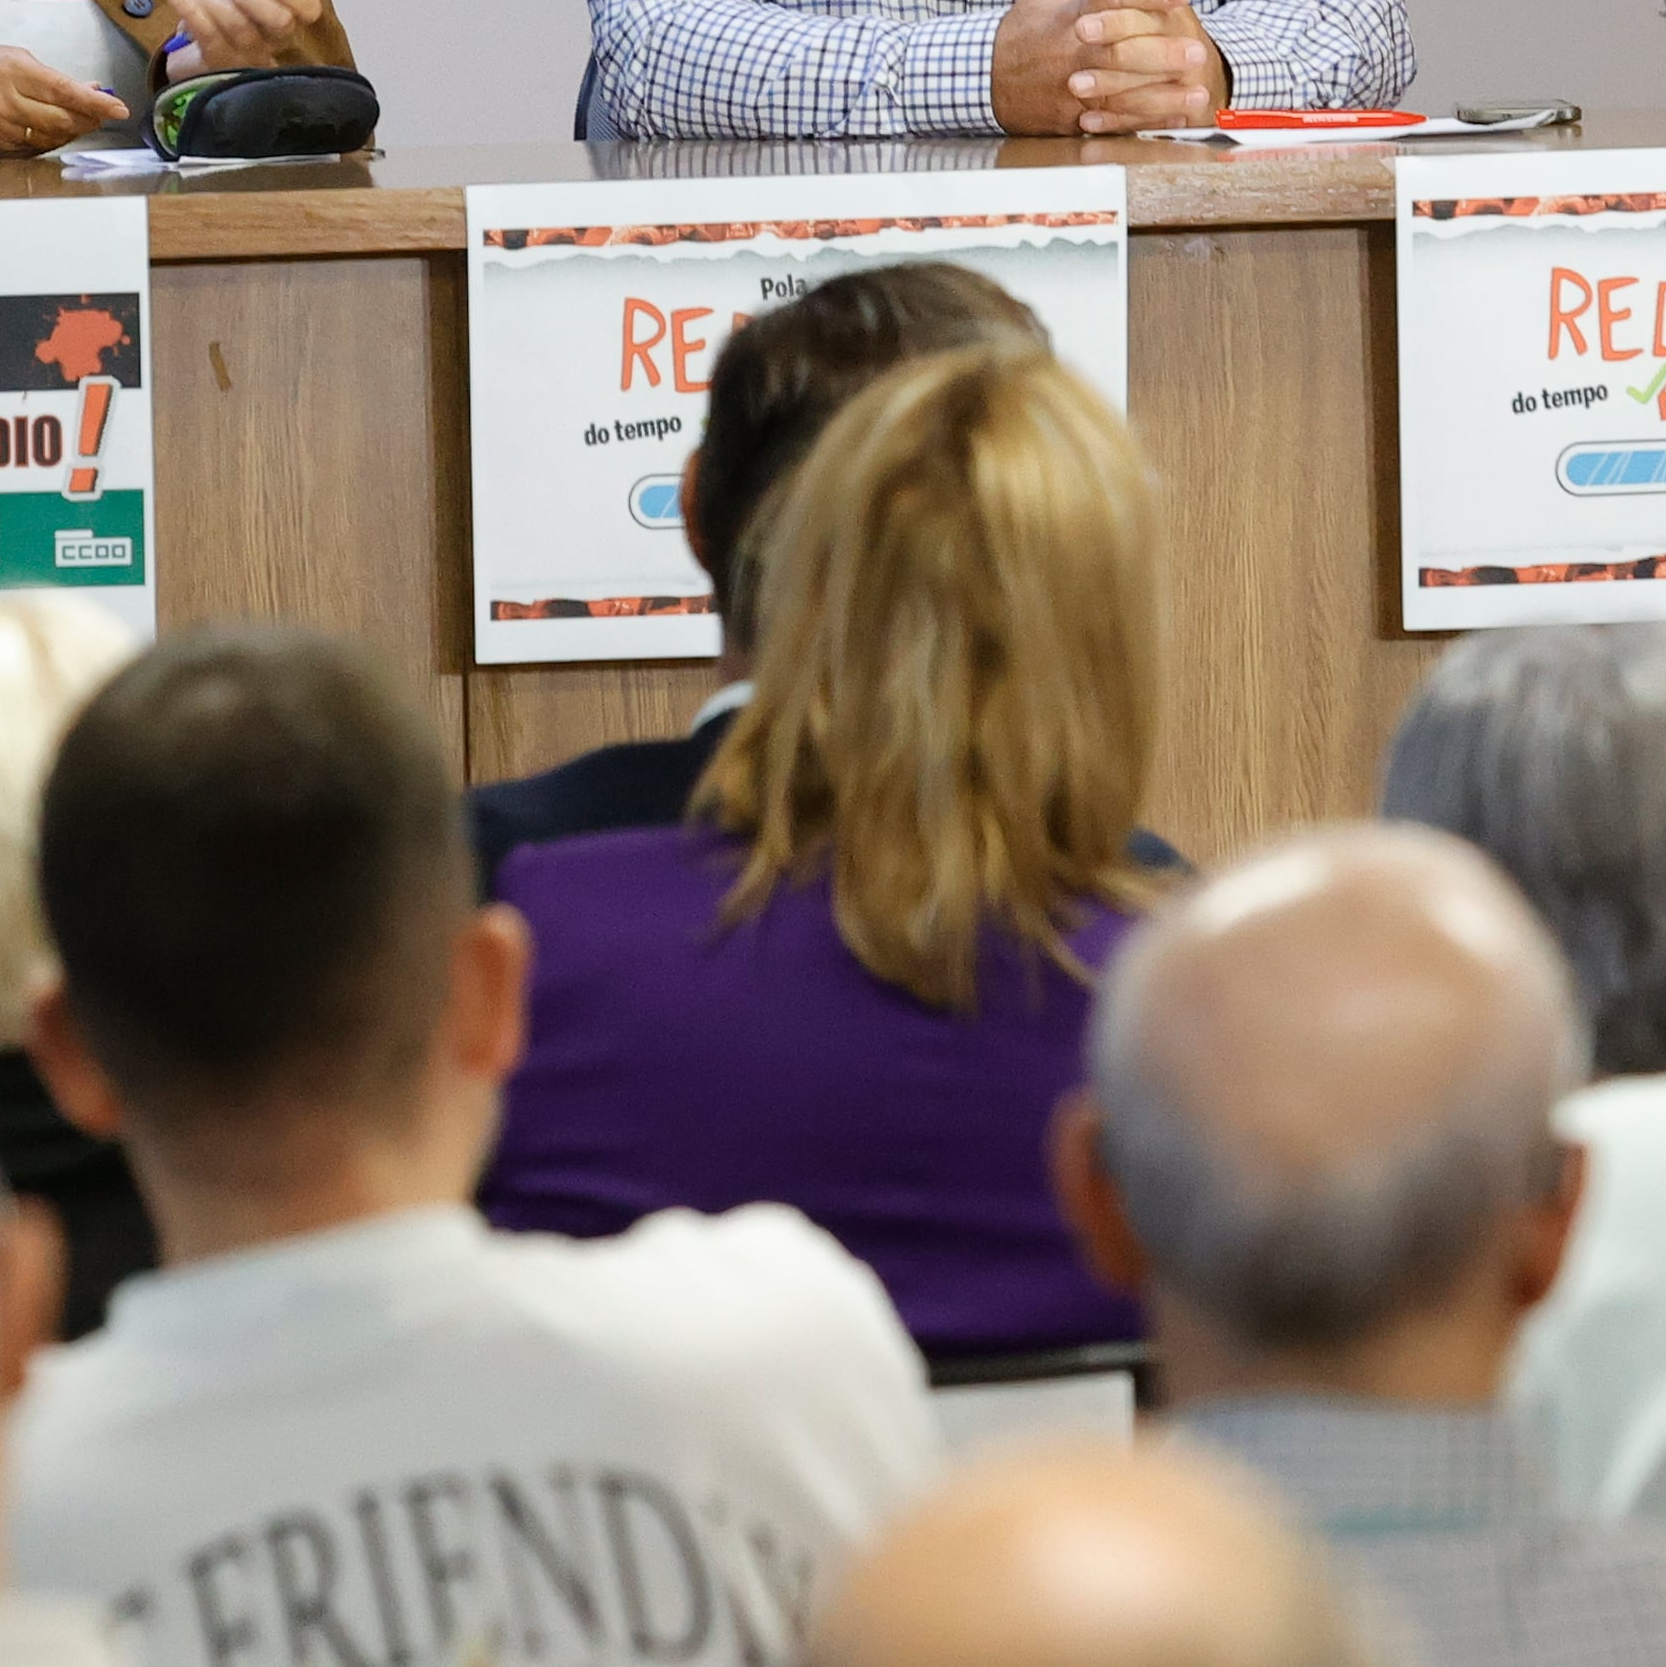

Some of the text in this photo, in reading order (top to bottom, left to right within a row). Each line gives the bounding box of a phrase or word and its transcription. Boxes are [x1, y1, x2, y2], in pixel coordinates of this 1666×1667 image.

[760, 273, 810, 301] Pola
[1511, 392, 1537, 415] do
[1541, 383, 1609, 409] tempo
[583, 416, 683, 446] do tempo
[61, 544, 127, 560] CCOO
